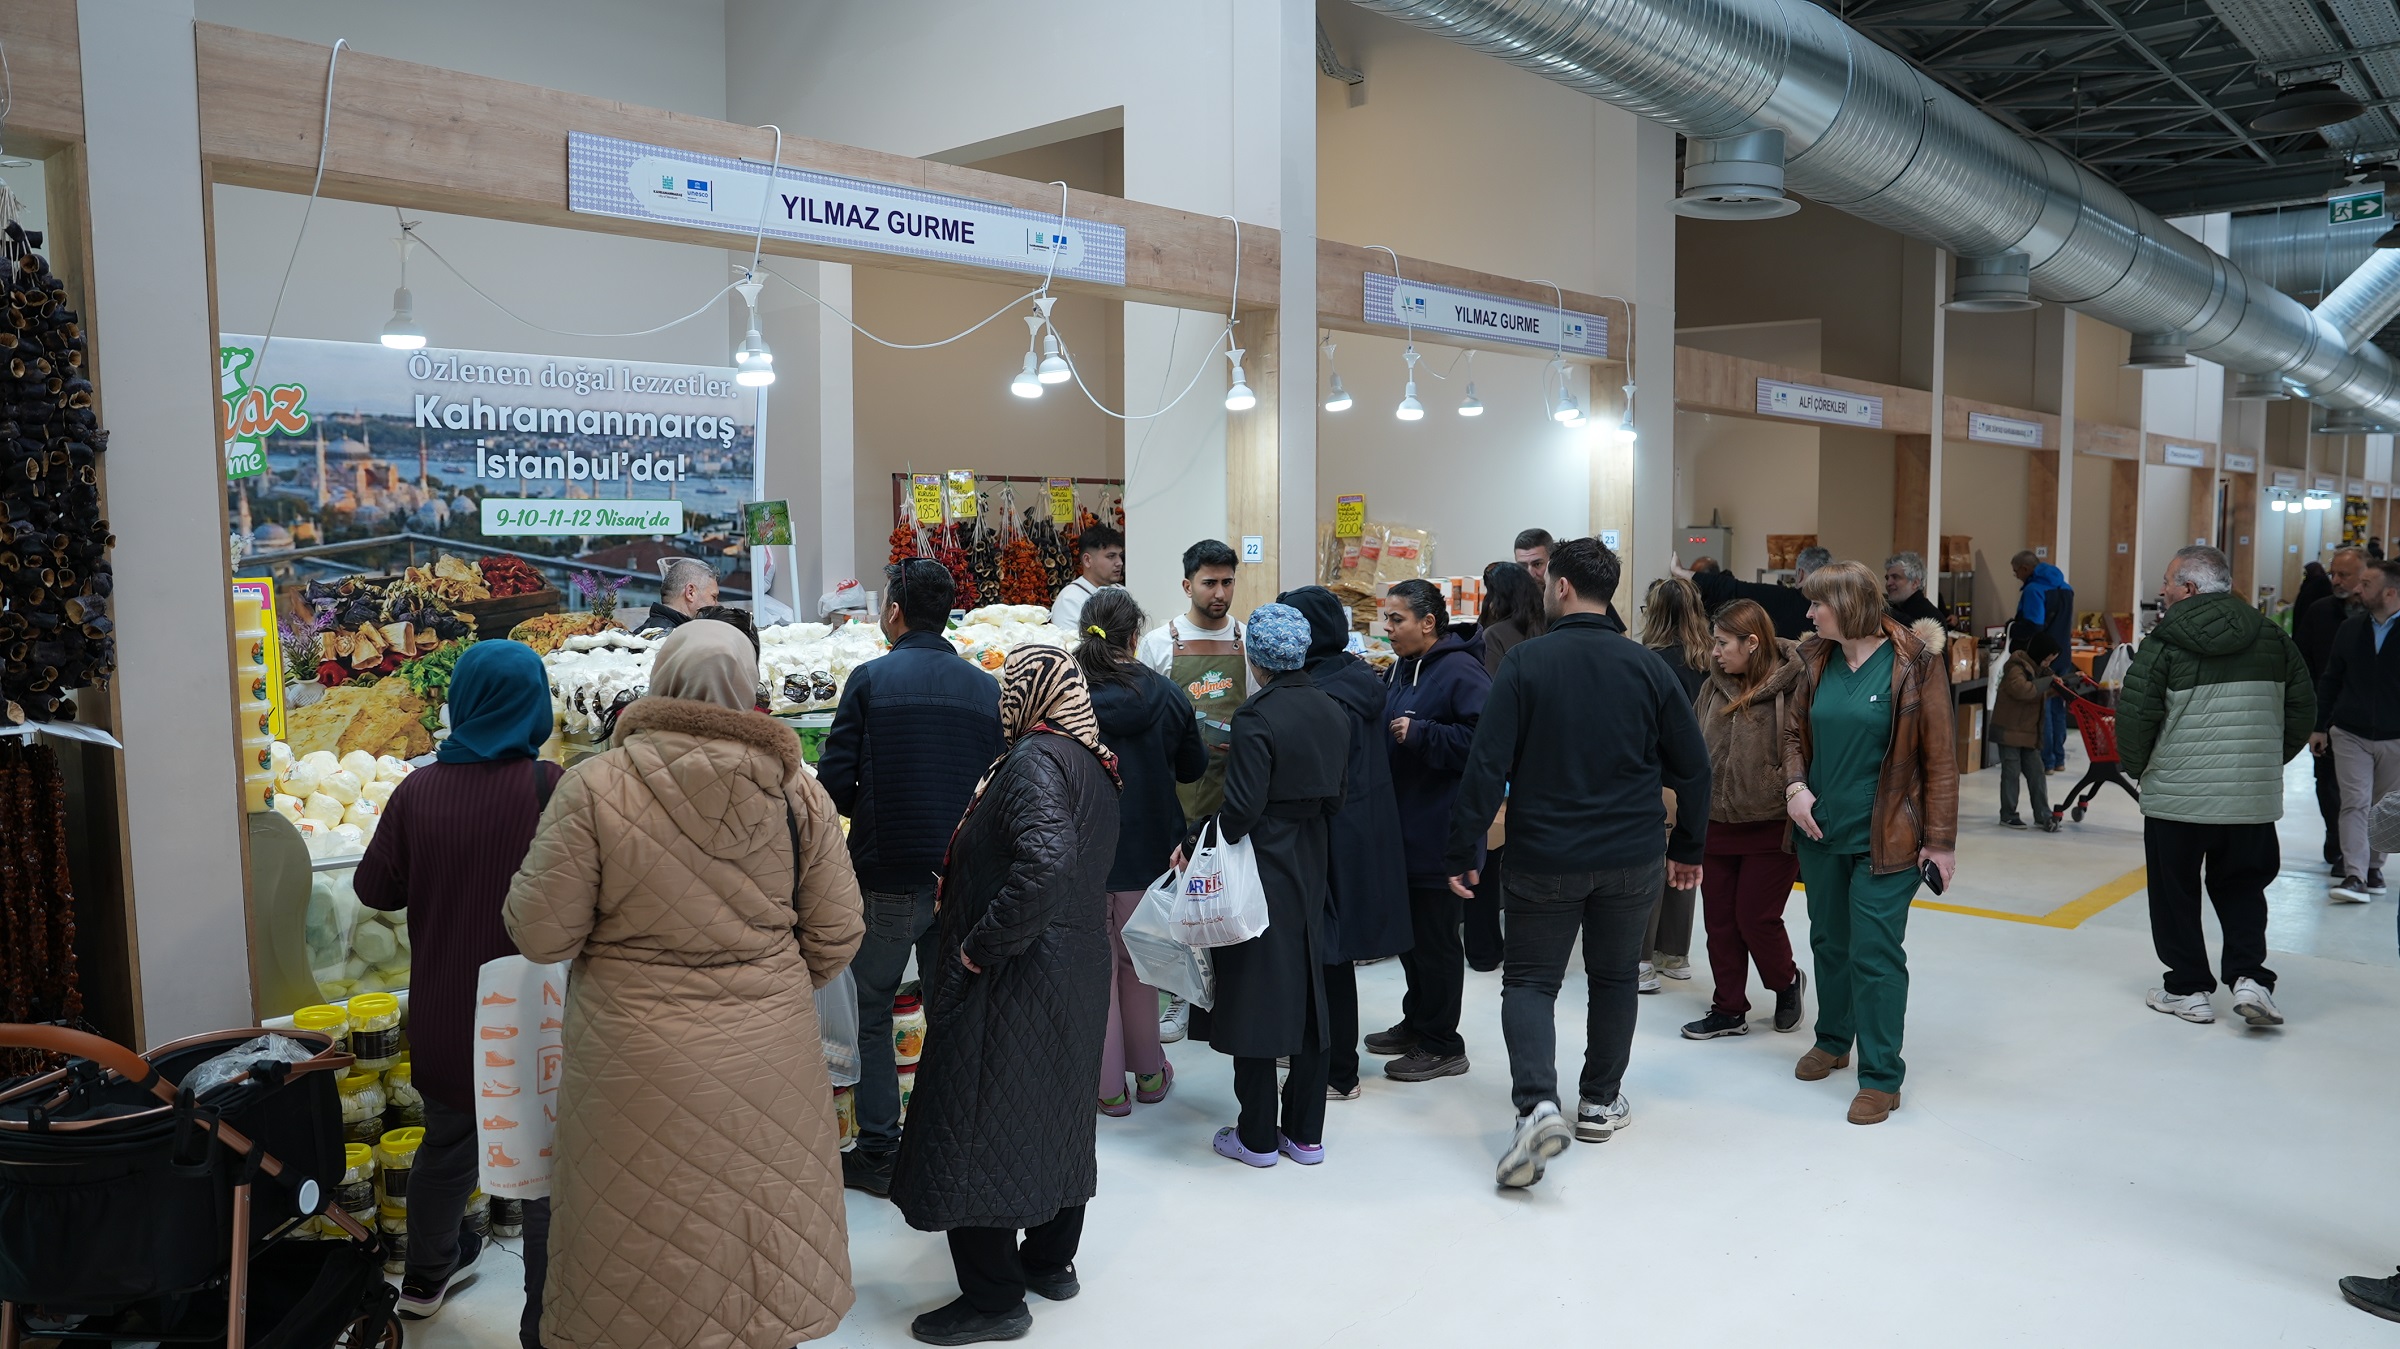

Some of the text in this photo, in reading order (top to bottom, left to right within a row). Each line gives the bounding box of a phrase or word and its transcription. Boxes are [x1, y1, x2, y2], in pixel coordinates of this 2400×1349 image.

[781, 194, 975, 245] YILMAZ GURME
[1455, 305, 1540, 334] YILMAZ GURME
[408, 350, 738, 399] Özlenen doğal lezzetler.
[1799, 395, 1814, 410] ALFİ
[1814, 396, 1848, 414] ÇÖREKLERİ
[414, 394, 736, 449] Kahramanmaraş
[496, 507, 591, 529] 9-10-11-12
[1247, 544, 1258, 555] 22
[1605, 536, 1615, 544] 23
